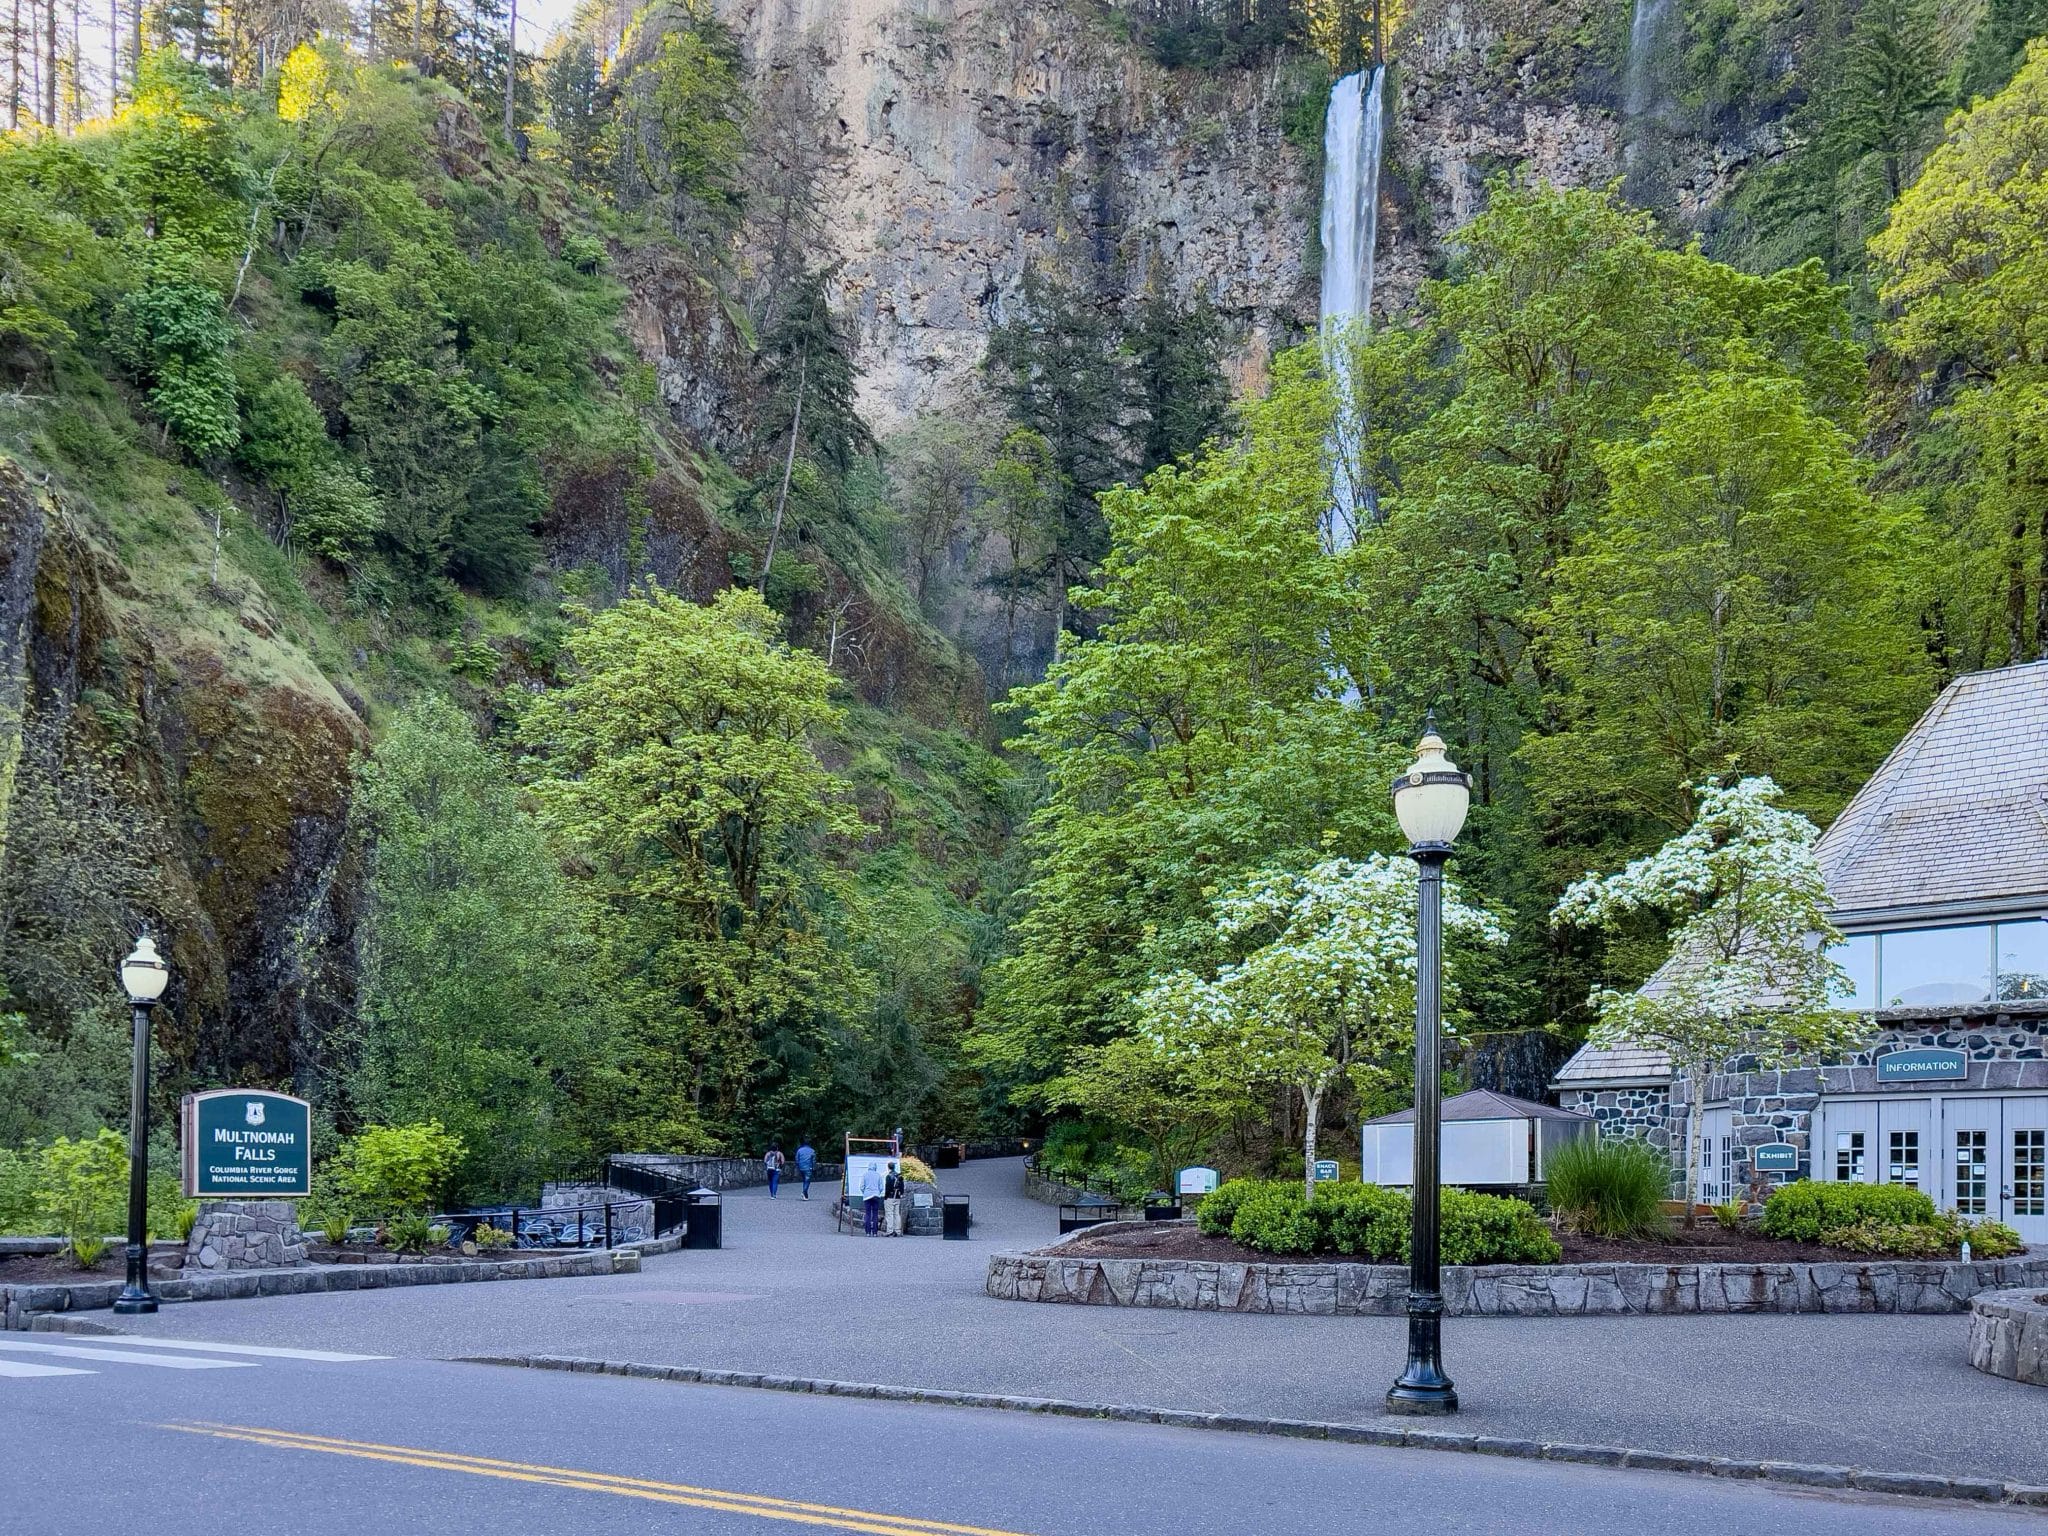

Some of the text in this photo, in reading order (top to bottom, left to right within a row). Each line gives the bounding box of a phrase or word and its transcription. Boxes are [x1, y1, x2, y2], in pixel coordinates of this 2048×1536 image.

[1886, 1061, 1957, 1072] INFORMATION
[214, 1128, 294, 1144] MULTNOMAH
[235, 1146, 276, 1161] FALLS
[209, 1165, 298, 1174] COLUMBIA RIVER GORGE
[211, 1174, 297, 1183] NATIONAL SCENIC AREA
